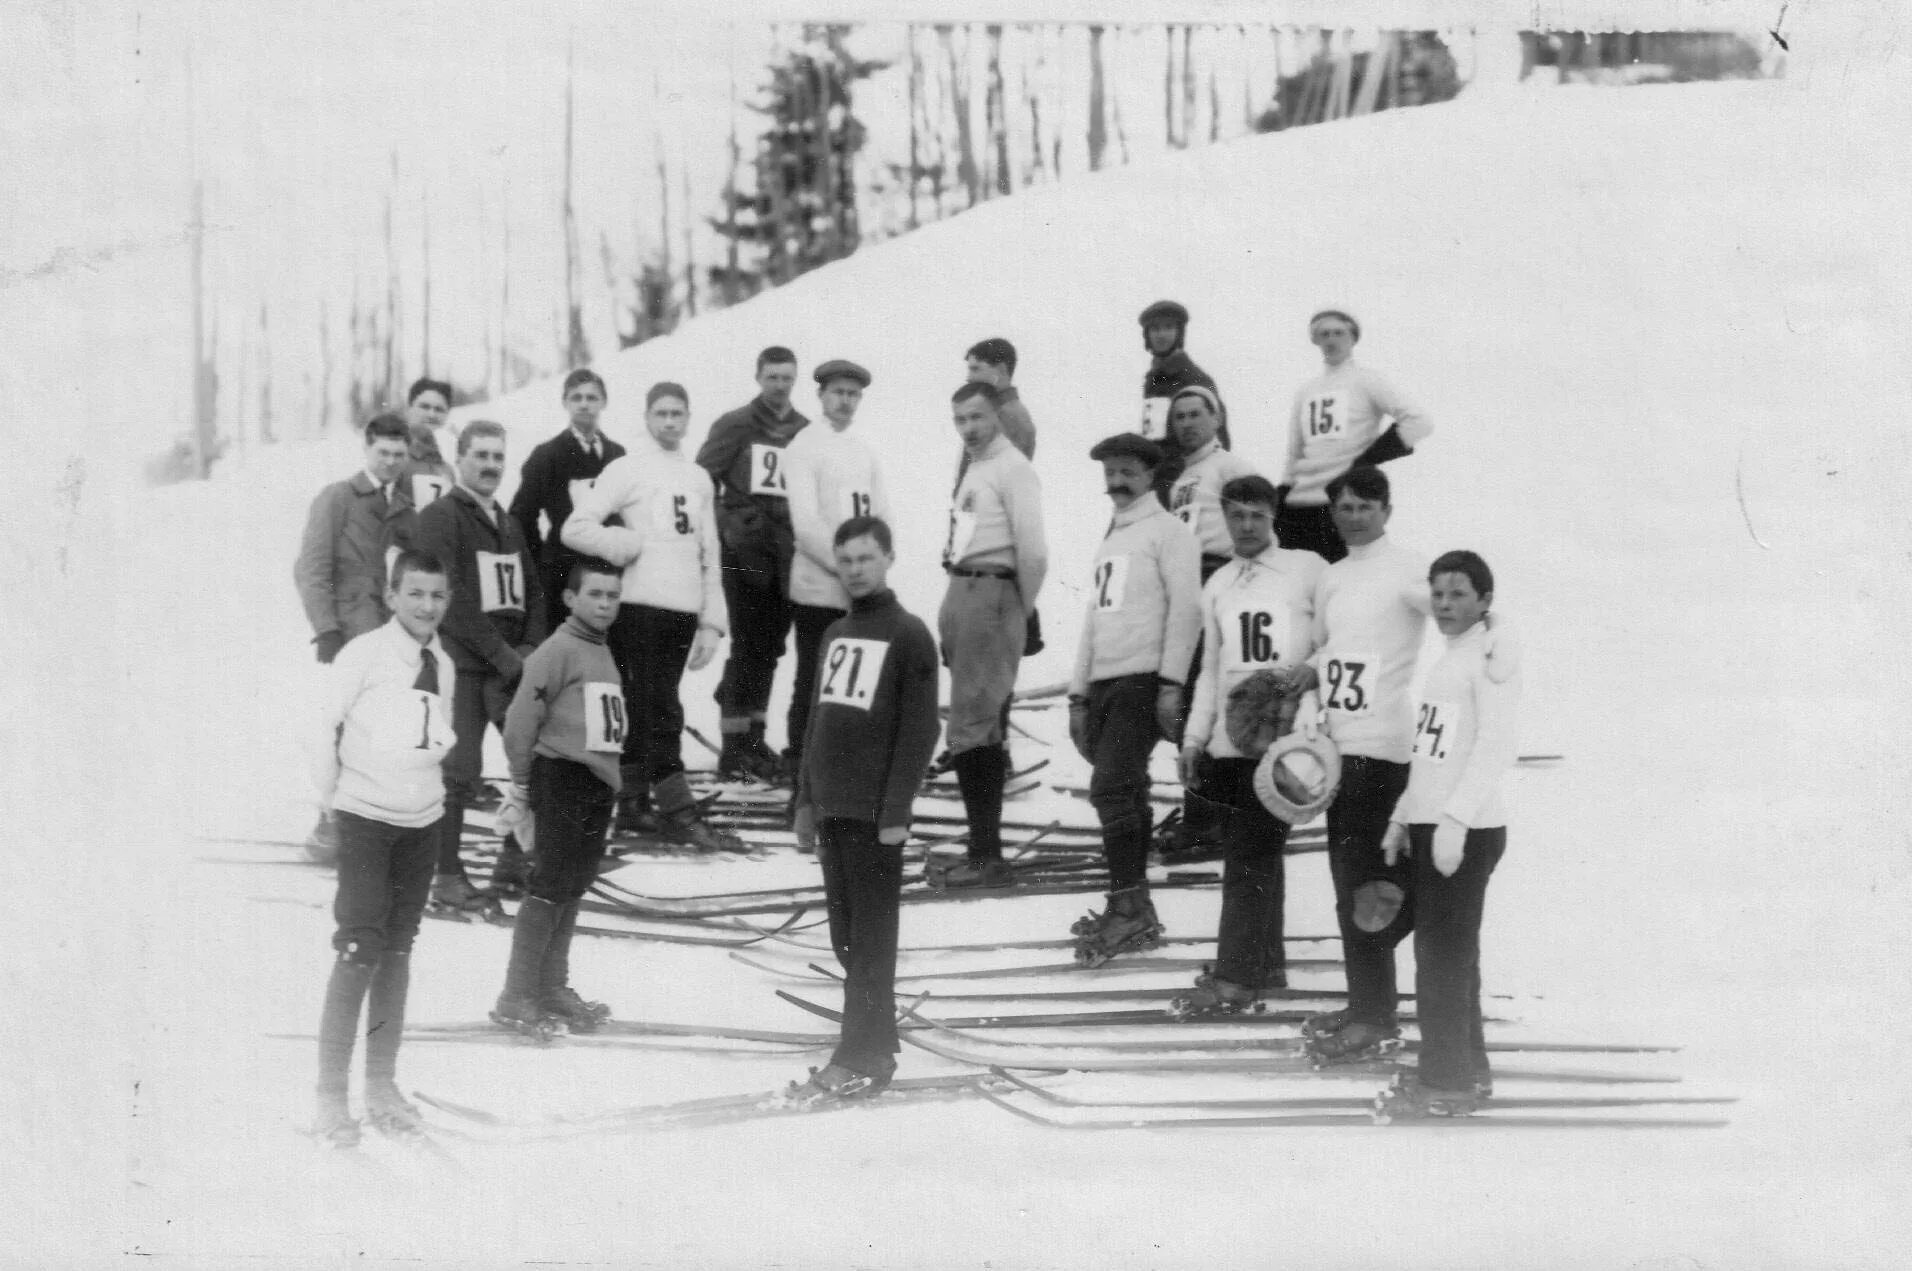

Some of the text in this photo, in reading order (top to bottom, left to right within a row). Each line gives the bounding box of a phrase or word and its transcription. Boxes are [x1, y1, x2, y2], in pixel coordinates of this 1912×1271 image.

[1309, 398, 1341, 436] 15.
[673, 495, 695, 535] 5.
[1239, 611, 1279, 663] 16.
[822, 644, 866, 698] 21.
[1327, 659, 1368, 711] 23.
